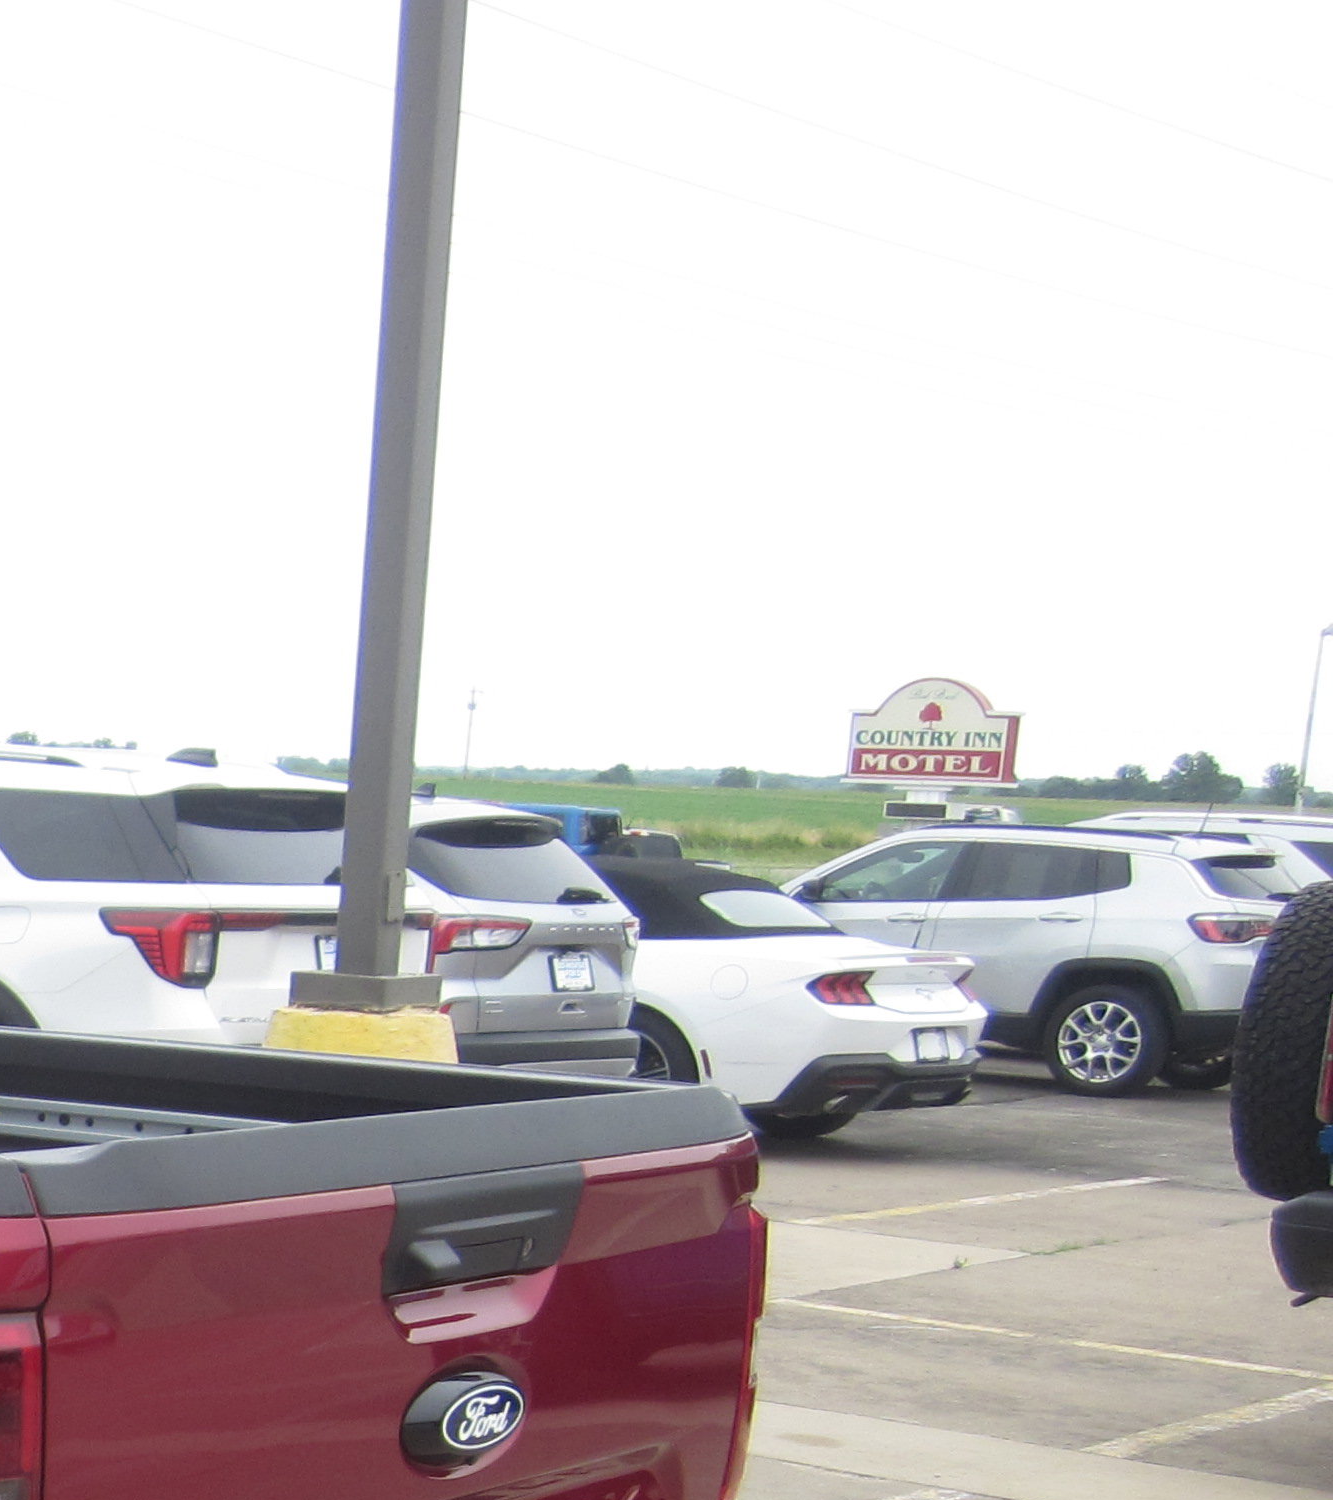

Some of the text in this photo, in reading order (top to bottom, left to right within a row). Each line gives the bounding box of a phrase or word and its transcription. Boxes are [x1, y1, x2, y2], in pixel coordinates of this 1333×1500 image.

[855, 729, 1004, 748] COUNTRY INN
[859, 753, 992, 774] MOTEL
[457, 1393, 512, 1442] Ford
